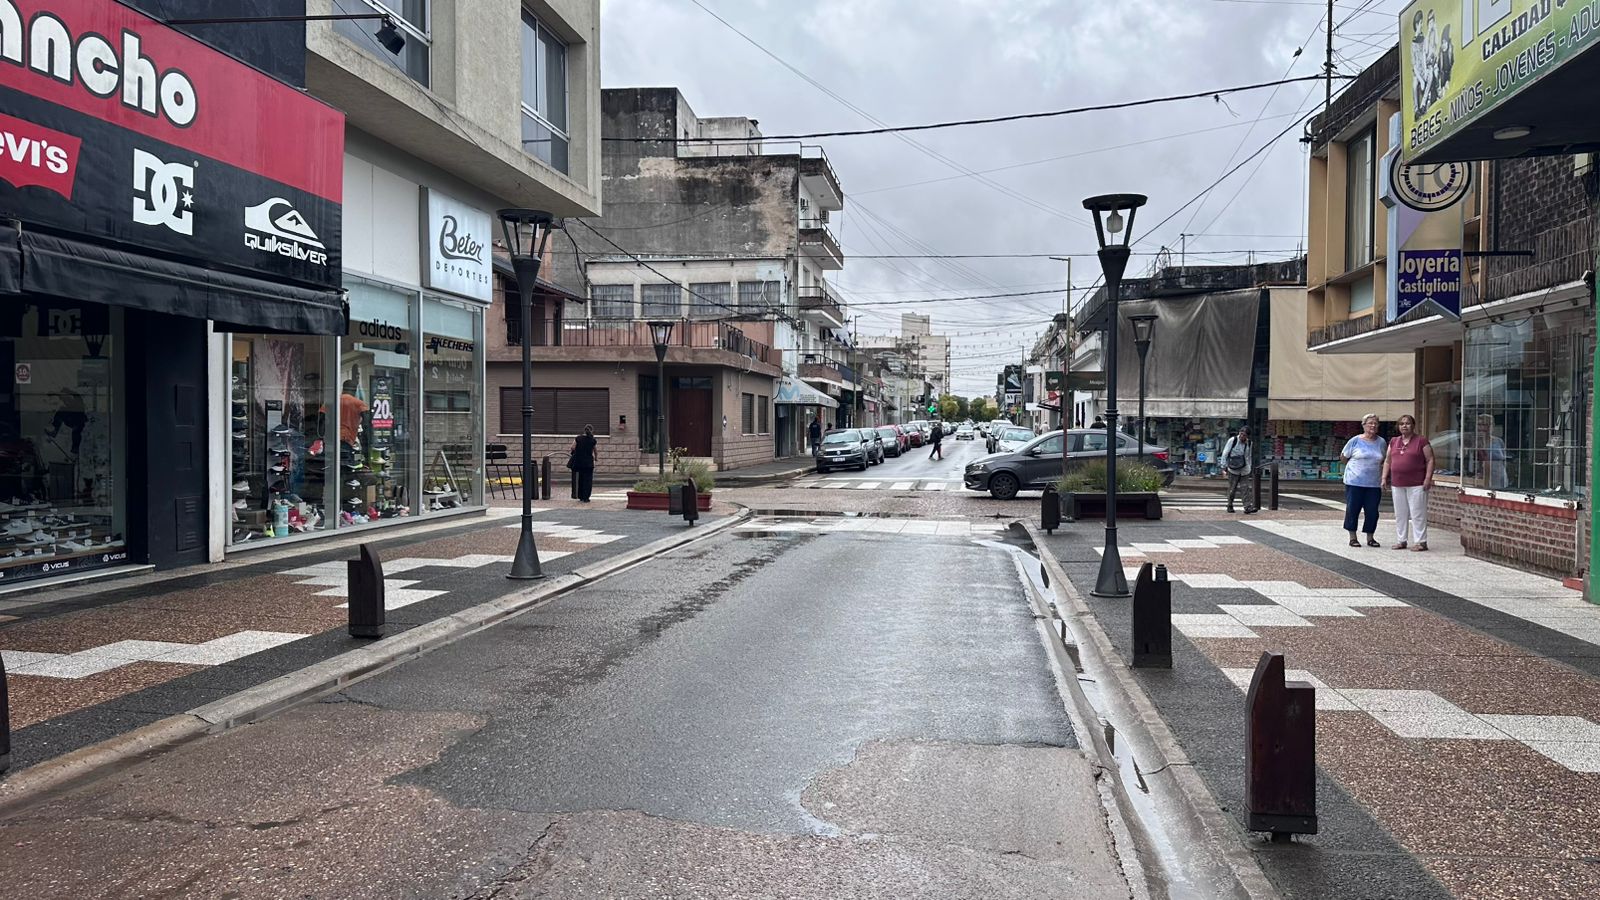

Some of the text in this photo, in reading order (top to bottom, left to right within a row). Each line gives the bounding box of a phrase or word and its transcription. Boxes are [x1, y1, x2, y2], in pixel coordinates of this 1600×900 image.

[1482, 0, 1552, 60] CALIDAD
[1410, 110, 1442, 149] BEBES
[1493, 31, 1556, 96] JOVENES
[133, 148, 194, 236] DC
[439, 215, 483, 263] Beter
[436, 260, 488, 284] DEPORTES
[1398, 252, 1460, 279] Joyería
[1398, 278, 1460, 297] Castiglioni
[360, 318, 402, 341] adidas
[426, 337, 475, 354] SKECHERS
[50, 561, 70, 570] VICUS
